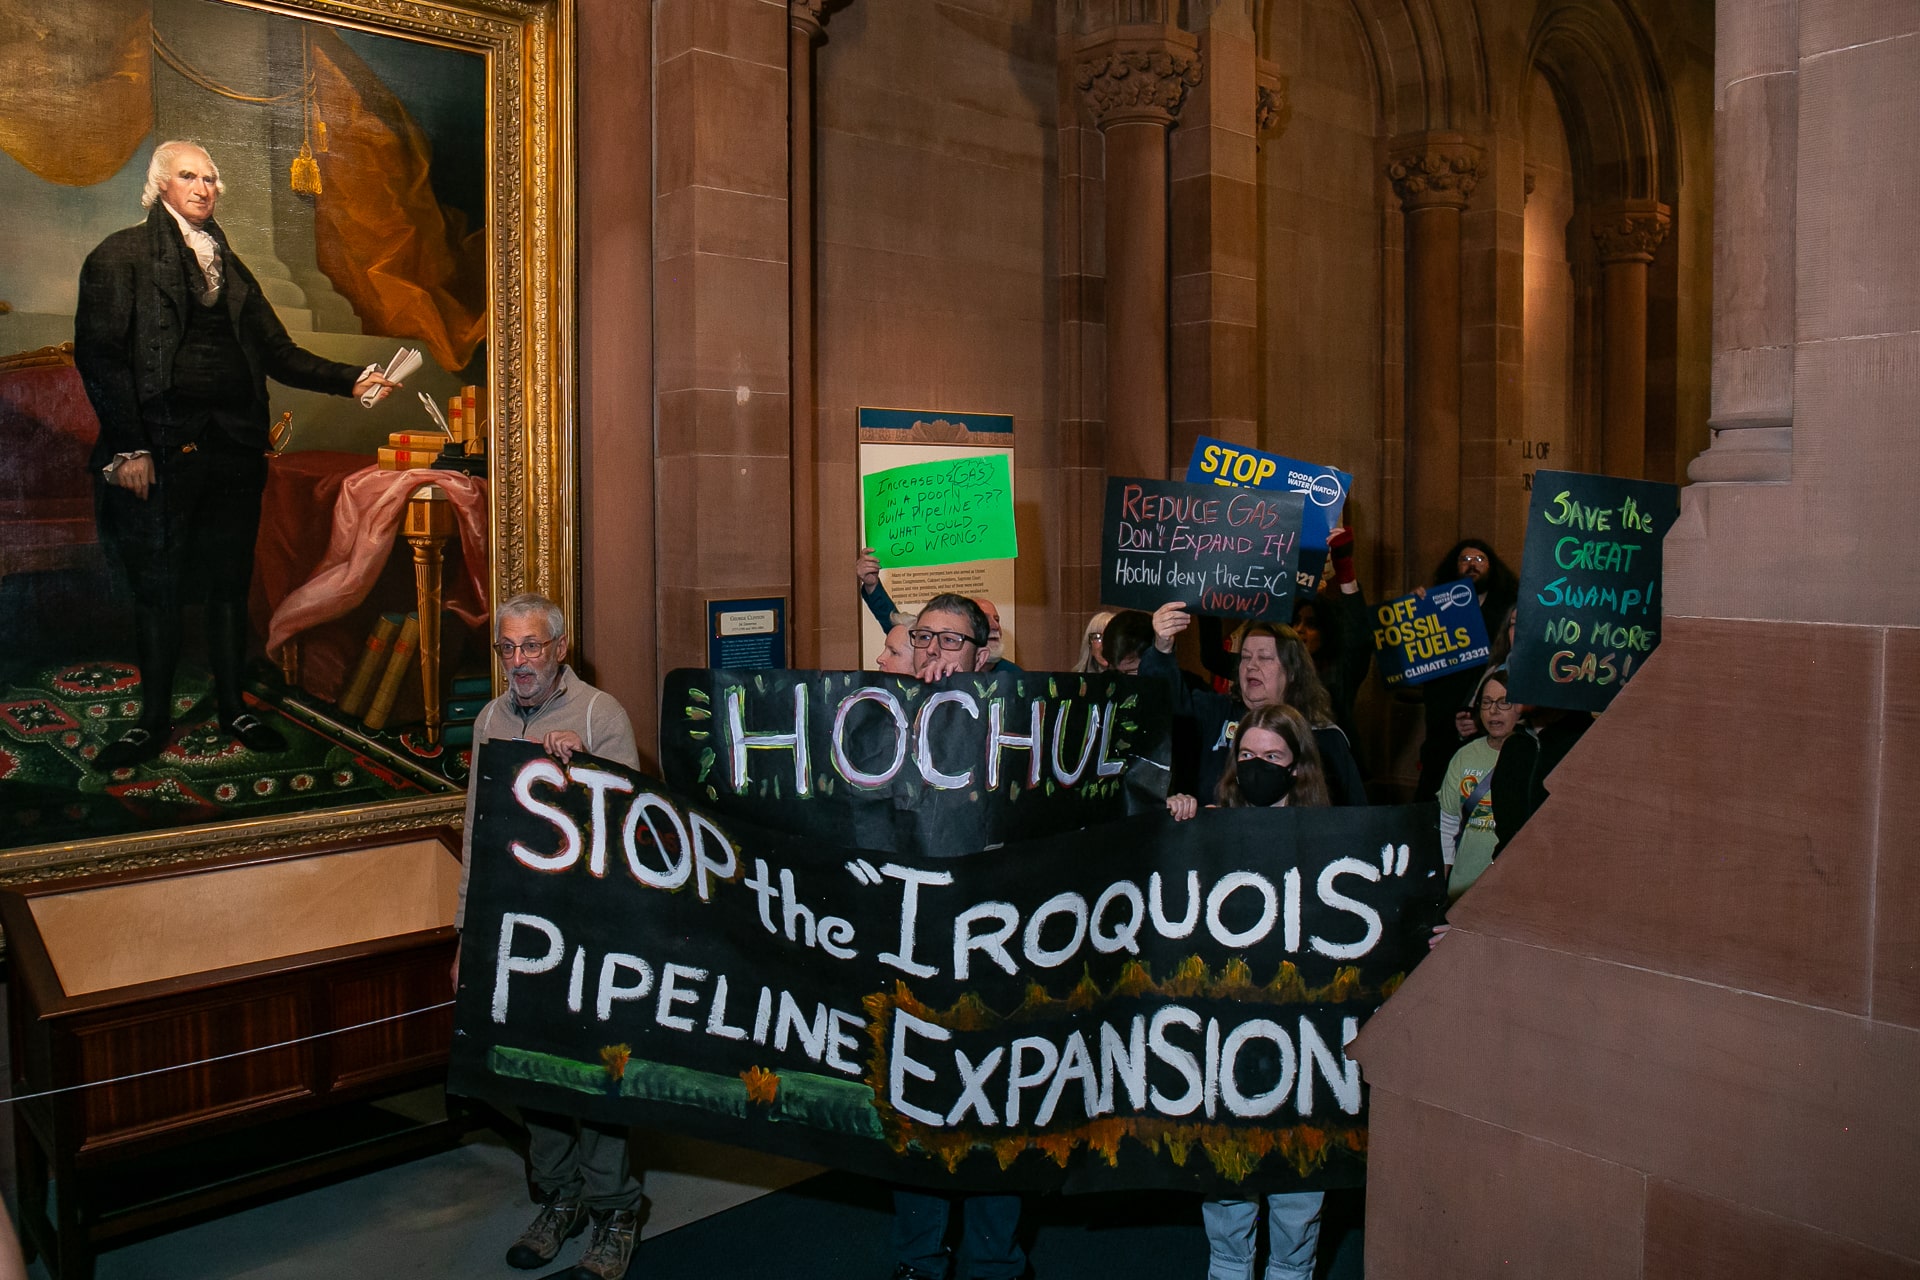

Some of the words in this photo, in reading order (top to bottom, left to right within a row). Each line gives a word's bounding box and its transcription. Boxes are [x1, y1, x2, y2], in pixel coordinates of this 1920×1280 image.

[1200, 445, 1277, 486] STOP
[1536, 441, 1550, 459] OF
[954, 466, 986, 484] GAS
[1287, 478, 1311, 489] WATER
[1312, 484, 1338, 497] WATCH
[878, 508, 906, 526] Built
[974, 489, 1003, 509] ???
[887, 498, 897, 508] IN
[903, 495, 911, 504] A
[1122, 484, 1220, 523] REDUCE
[1227, 494, 1280, 530] GAS
[1544, 490, 1612, 532] SAVE
[1617, 495, 1653, 533] the
[889, 525, 922, 540] WHAT
[927, 516, 973, 533] COULD
[890, 541, 915, 556] GO
[925, 524, 989, 551] WRONG?
[1170, 526, 1254, 560] EXPAND
[1115, 558, 1162, 586] Hochul
[1213, 563, 1245, 586] the
[1554, 536, 1642, 573] GREAT
[1201, 587, 1270, 616] (NOW!)
[1378, 598, 1417, 627] OFF
[1536, 577, 1654, 616] SWAMP!
[1373, 613, 1447, 650] FOSSIL
[1404, 627, 1471, 663] FUELS
[1544, 617, 1581, 645] NO
[1590, 621, 1657, 651] MORE
[1386, 673, 1404, 684] TEXT
[1404, 658, 1447, 679] CLIMATE
[1448, 658, 1458, 666] TO
[1459, 646, 1490, 663] 23321
[1548, 650, 1632, 686] GAS!
[726, 682, 1126, 797] HOCHUL
[1463, 768, 1484, 777] NEW
[509, 758, 739, 900] STOP
[744, 857, 859, 959] the
[845, 843, 1410, 980] "IROQUOIS"
[491, 912, 867, 1075] PIPELINE
[890, 1004, 1363, 1128] EXPANSION
